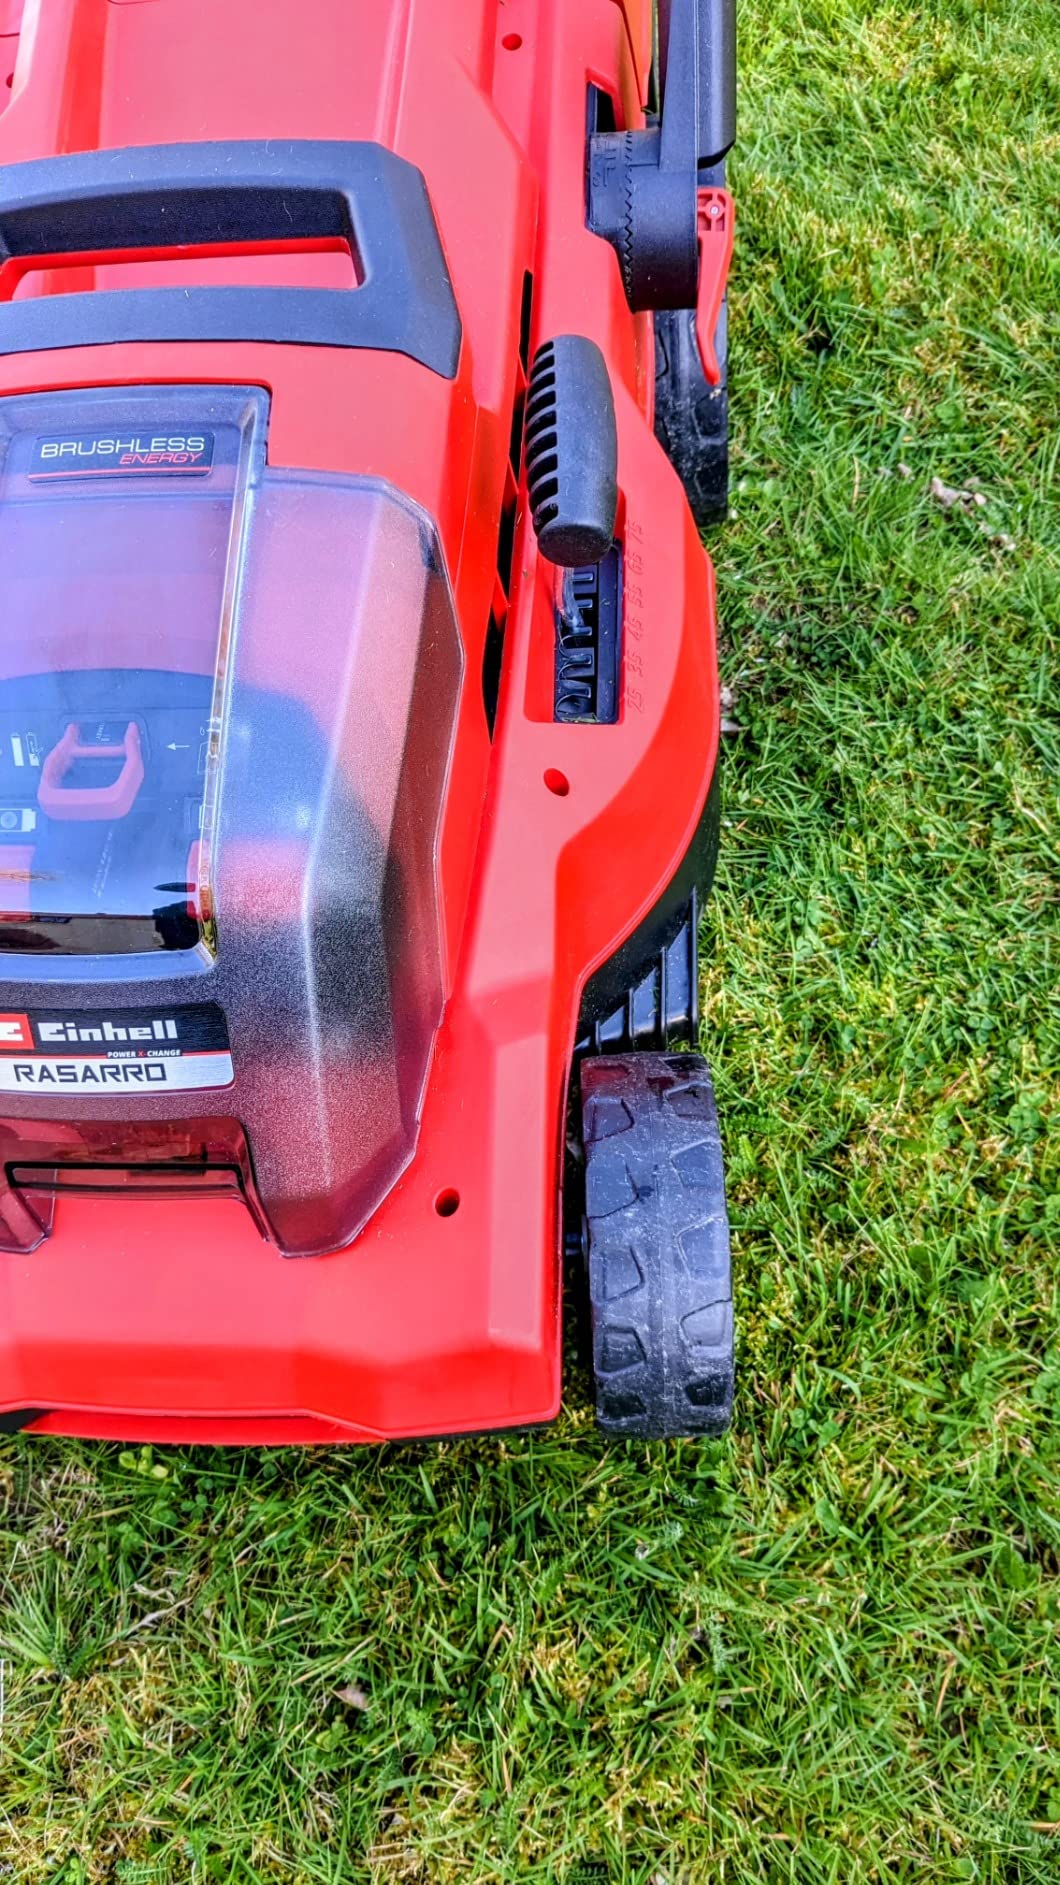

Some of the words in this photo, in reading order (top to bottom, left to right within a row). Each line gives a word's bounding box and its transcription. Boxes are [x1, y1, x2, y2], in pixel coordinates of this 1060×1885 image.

[41, 437, 205, 457] BRUSHLESS
[120, 453, 202, 464] ENERGY
[627, 520, 644, 544] 75
[627, 551, 644, 575] 65
[627, 584, 644, 608] 55
[627, 618, 644, 642] 45
[627, 651, 644, 677] 35
[627, 687, 644, 713] 25
[37, 1020, 178, 1041] Einhell
[13, 1063, 167, 1083] RASARRO
